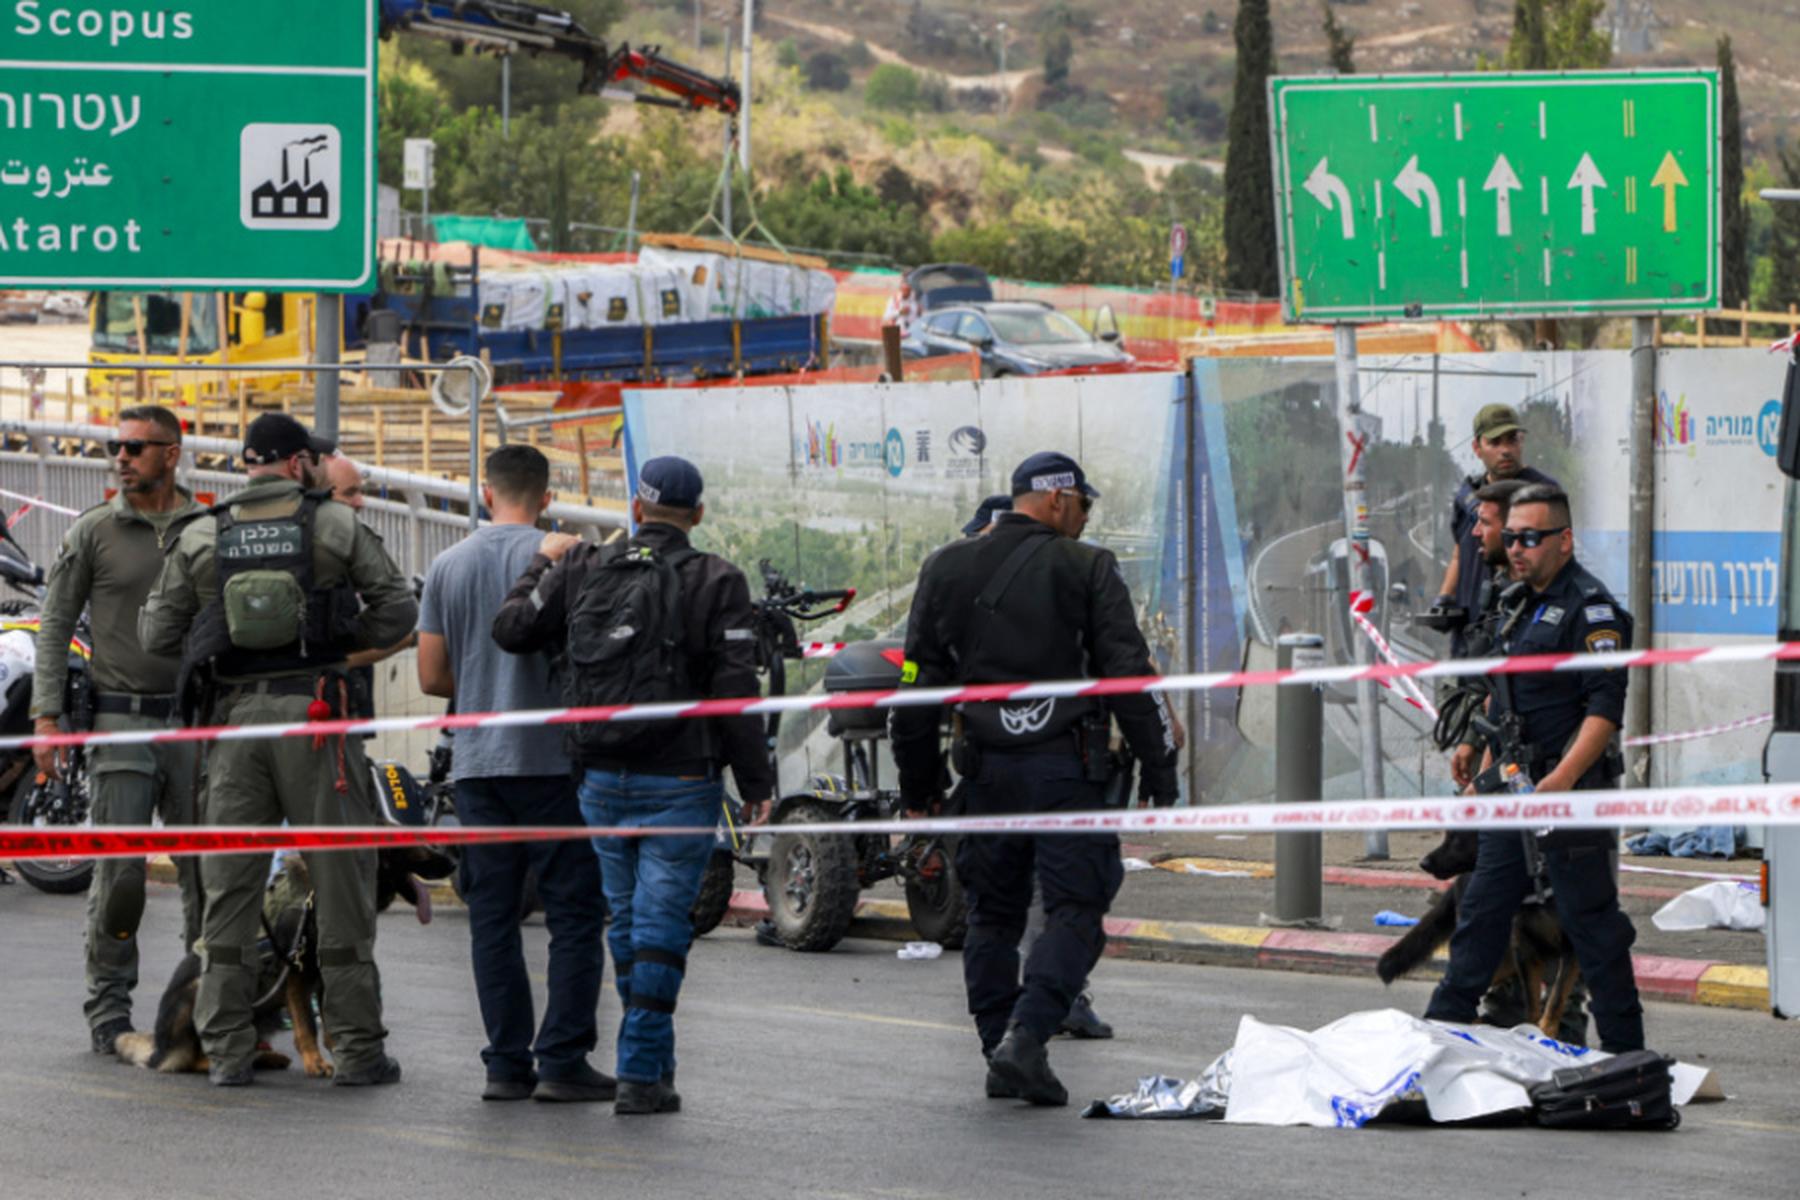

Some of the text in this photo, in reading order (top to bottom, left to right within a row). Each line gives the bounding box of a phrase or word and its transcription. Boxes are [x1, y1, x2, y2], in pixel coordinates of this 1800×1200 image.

[15, 0, 194, 47] Scopus
[0, 157, 113, 198] عتروت
[1706, 415, 1753, 436] מוריה
[241, 524, 280, 544] כלבן
[1722, 556, 1778, 615] לדרך
